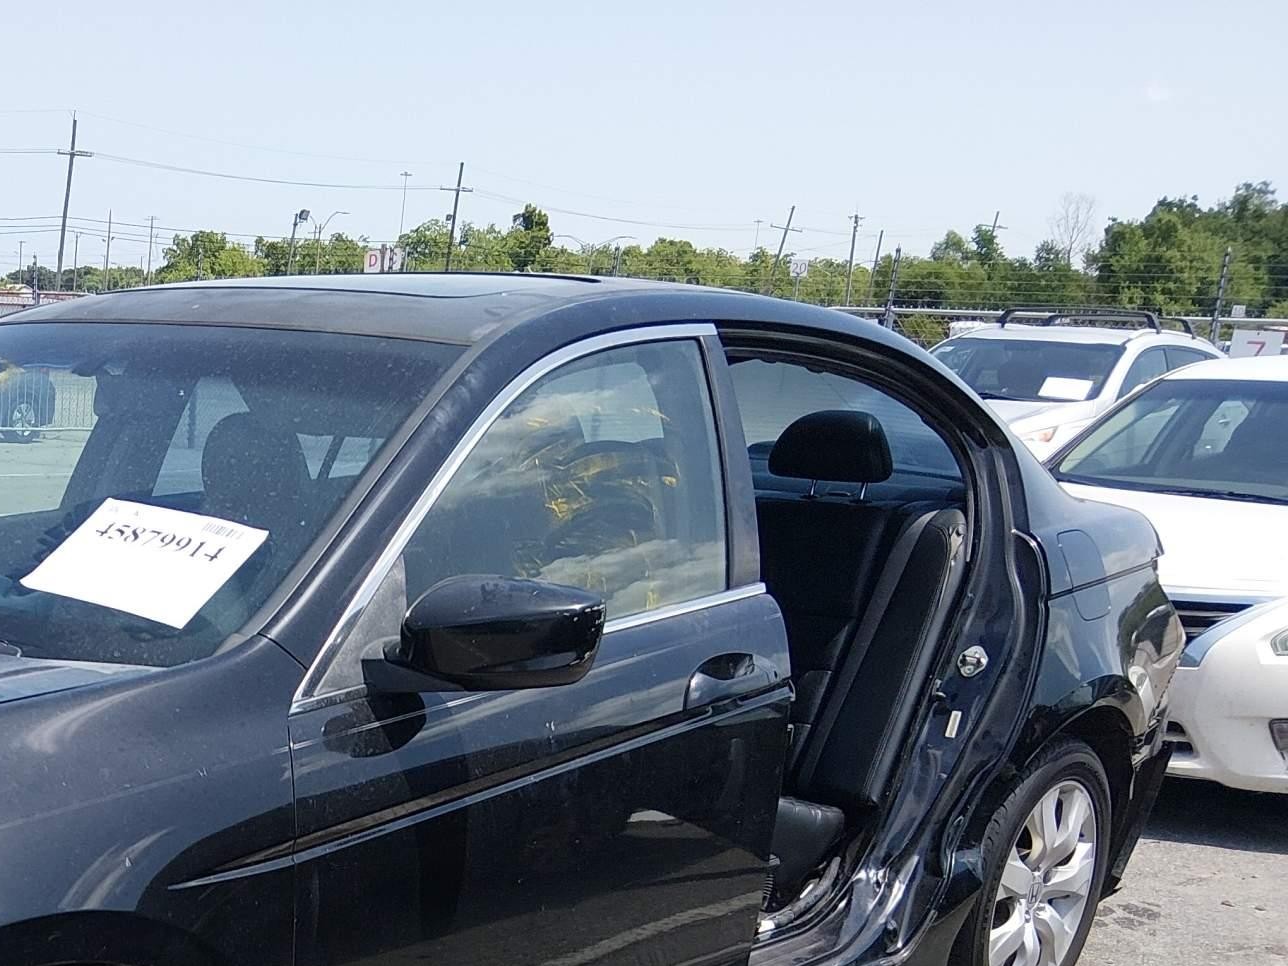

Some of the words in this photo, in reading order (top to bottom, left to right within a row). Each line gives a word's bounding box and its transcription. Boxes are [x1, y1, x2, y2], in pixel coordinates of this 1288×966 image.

[369, 254, 377, 267] D
[792, 262, 807, 275] 20
[1246, 340, 1266, 356] 7
[95, 521, 227, 562] 45879914
